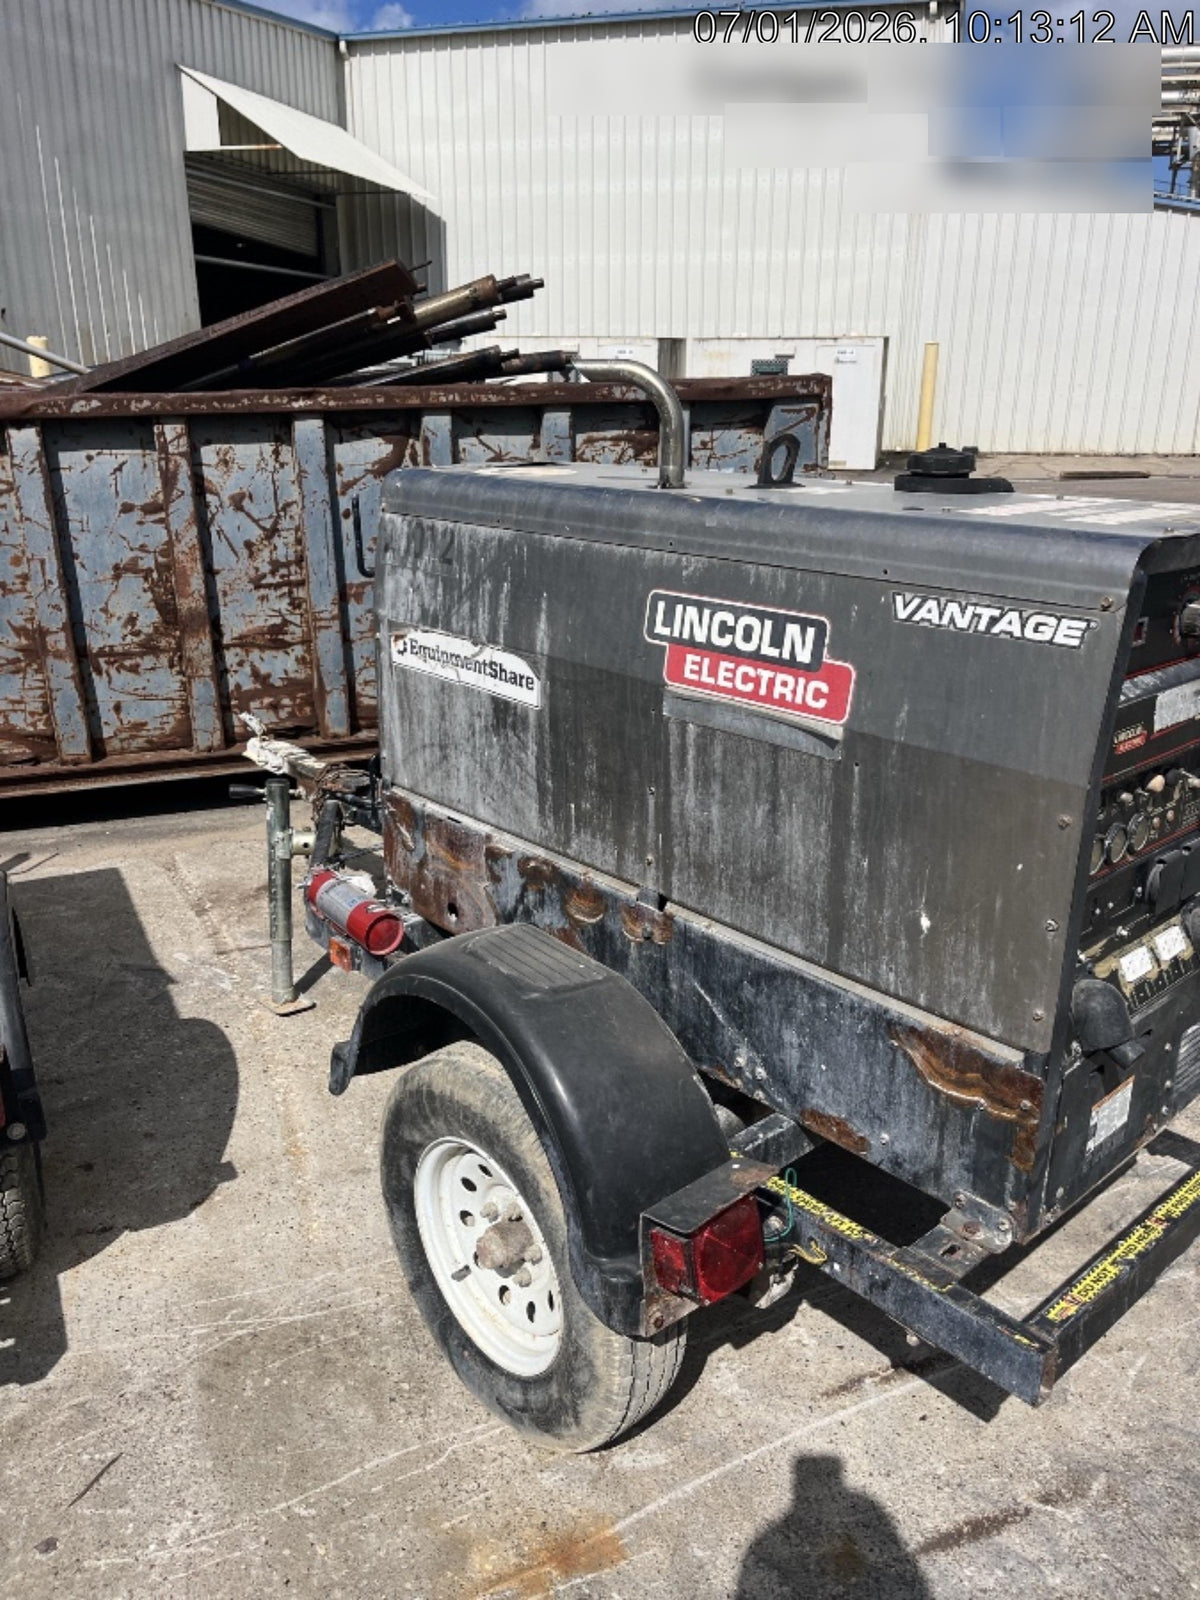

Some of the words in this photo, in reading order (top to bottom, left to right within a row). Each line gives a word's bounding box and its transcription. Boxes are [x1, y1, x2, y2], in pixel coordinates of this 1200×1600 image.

[654, 600, 816, 664] LINCOLN
[894, 594, 1089, 648] VANTAGE
[408, 638, 535, 691] EquipmentShare
[683, 653, 830, 710] ELECTRIC
